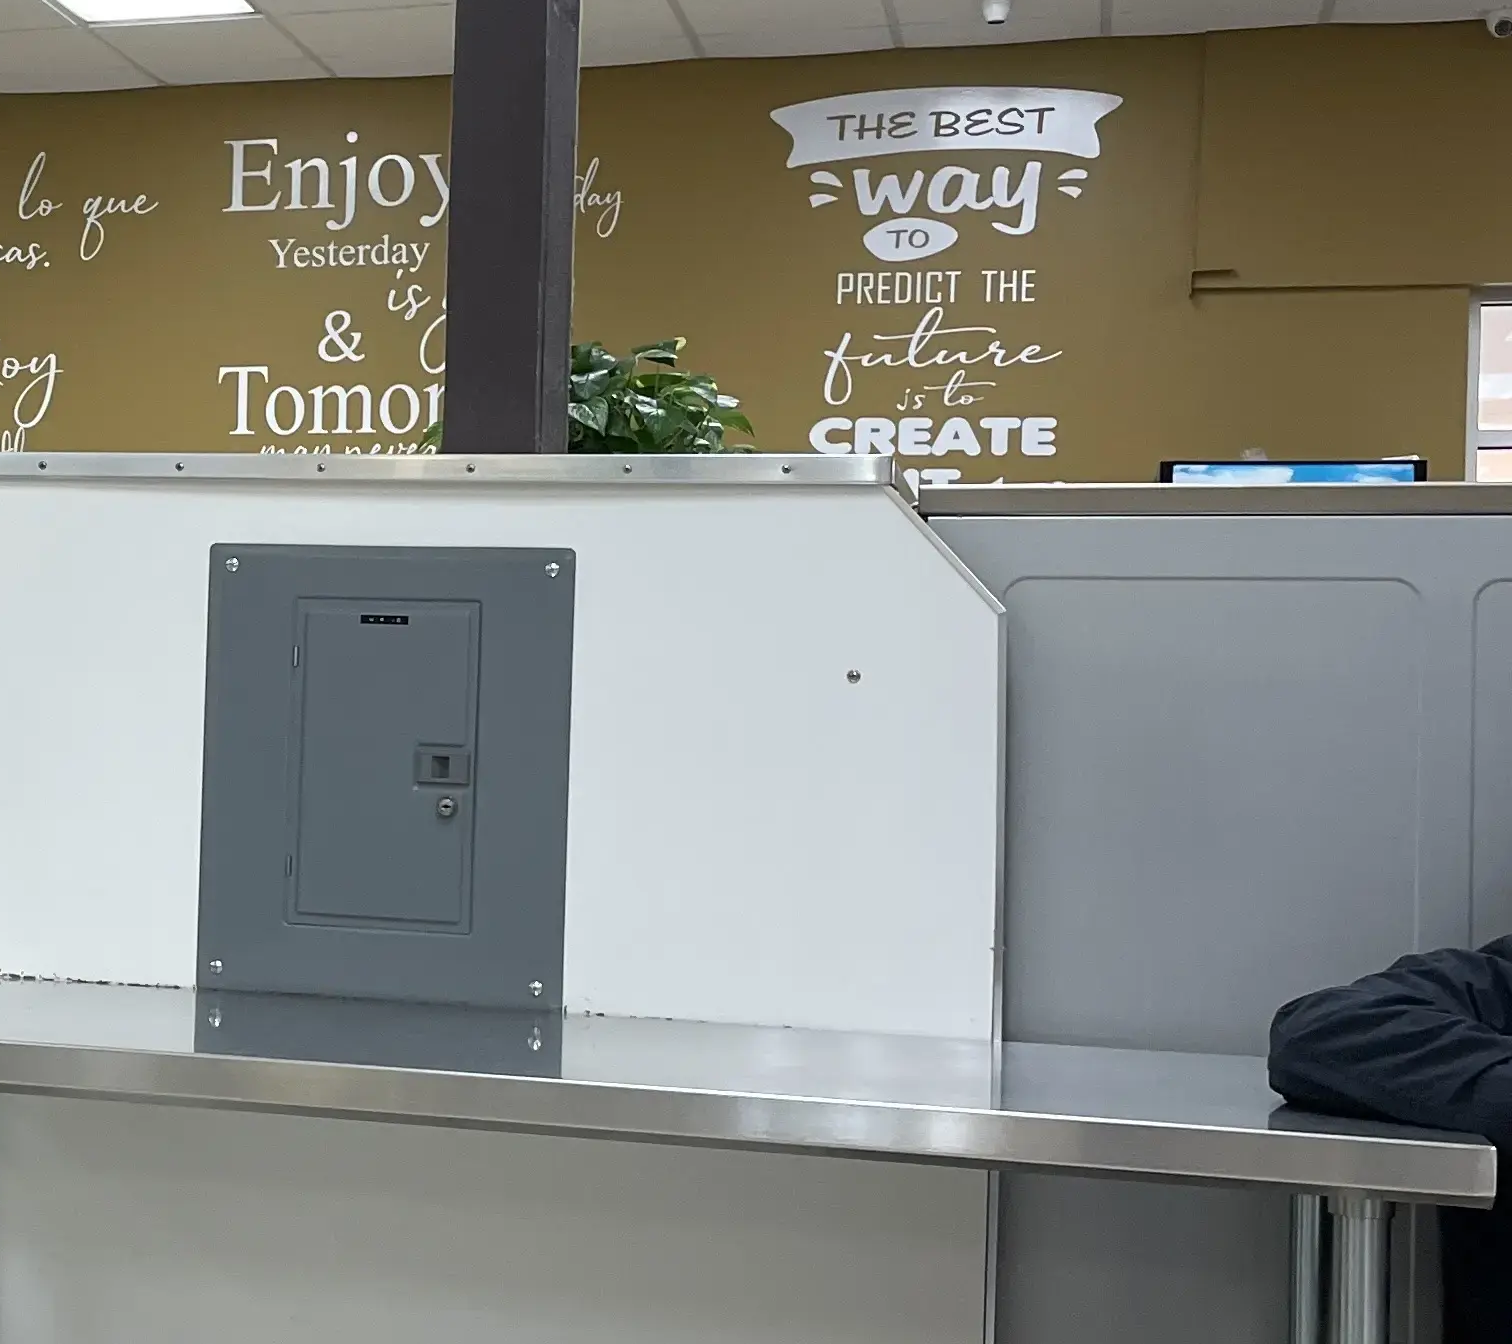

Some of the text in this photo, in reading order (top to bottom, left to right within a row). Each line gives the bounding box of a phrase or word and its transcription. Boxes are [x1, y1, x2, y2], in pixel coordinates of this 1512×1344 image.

[826, 106, 1056, 143] THE BEST
[17, 150, 64, 221] lo
[78, 190, 160, 262] que
[221, 130, 624, 239] Enjoy day
[852, 160, 1043, 236] way
[268, 232, 431, 273] Yesterday
[885, 228, 931, 250] TO
[386, 268, 432, 322] is
[835, 268, 1037, 306] PREDICT THE
[316, 309, 366, 364] &
[822, 305, 1064, 406] future
[217, 364, 446, 436] Tomor
[895, 368, 998, 412] is to
[808, 415, 1059, 457] CREATE
